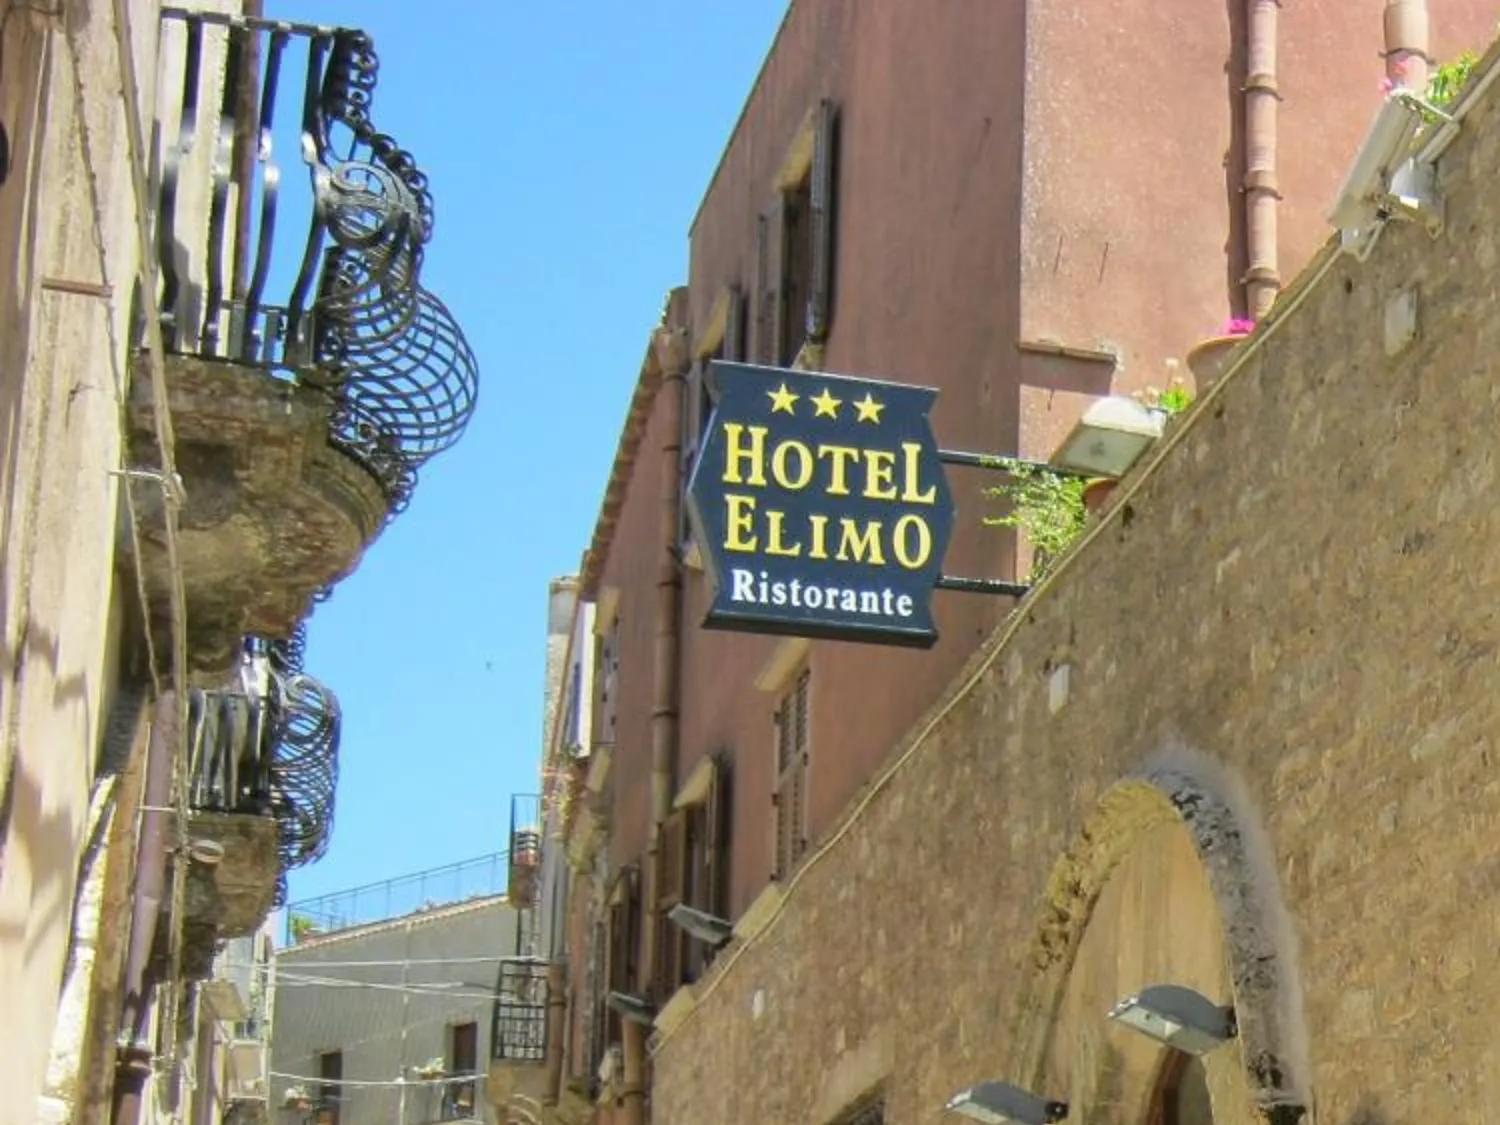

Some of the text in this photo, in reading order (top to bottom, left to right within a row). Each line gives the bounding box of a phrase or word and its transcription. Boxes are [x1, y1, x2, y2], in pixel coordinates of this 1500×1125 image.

[722, 423, 937, 505] HOTEL
[723, 494, 932, 569] ELIMO
[731, 569, 913, 617] Ristorante
